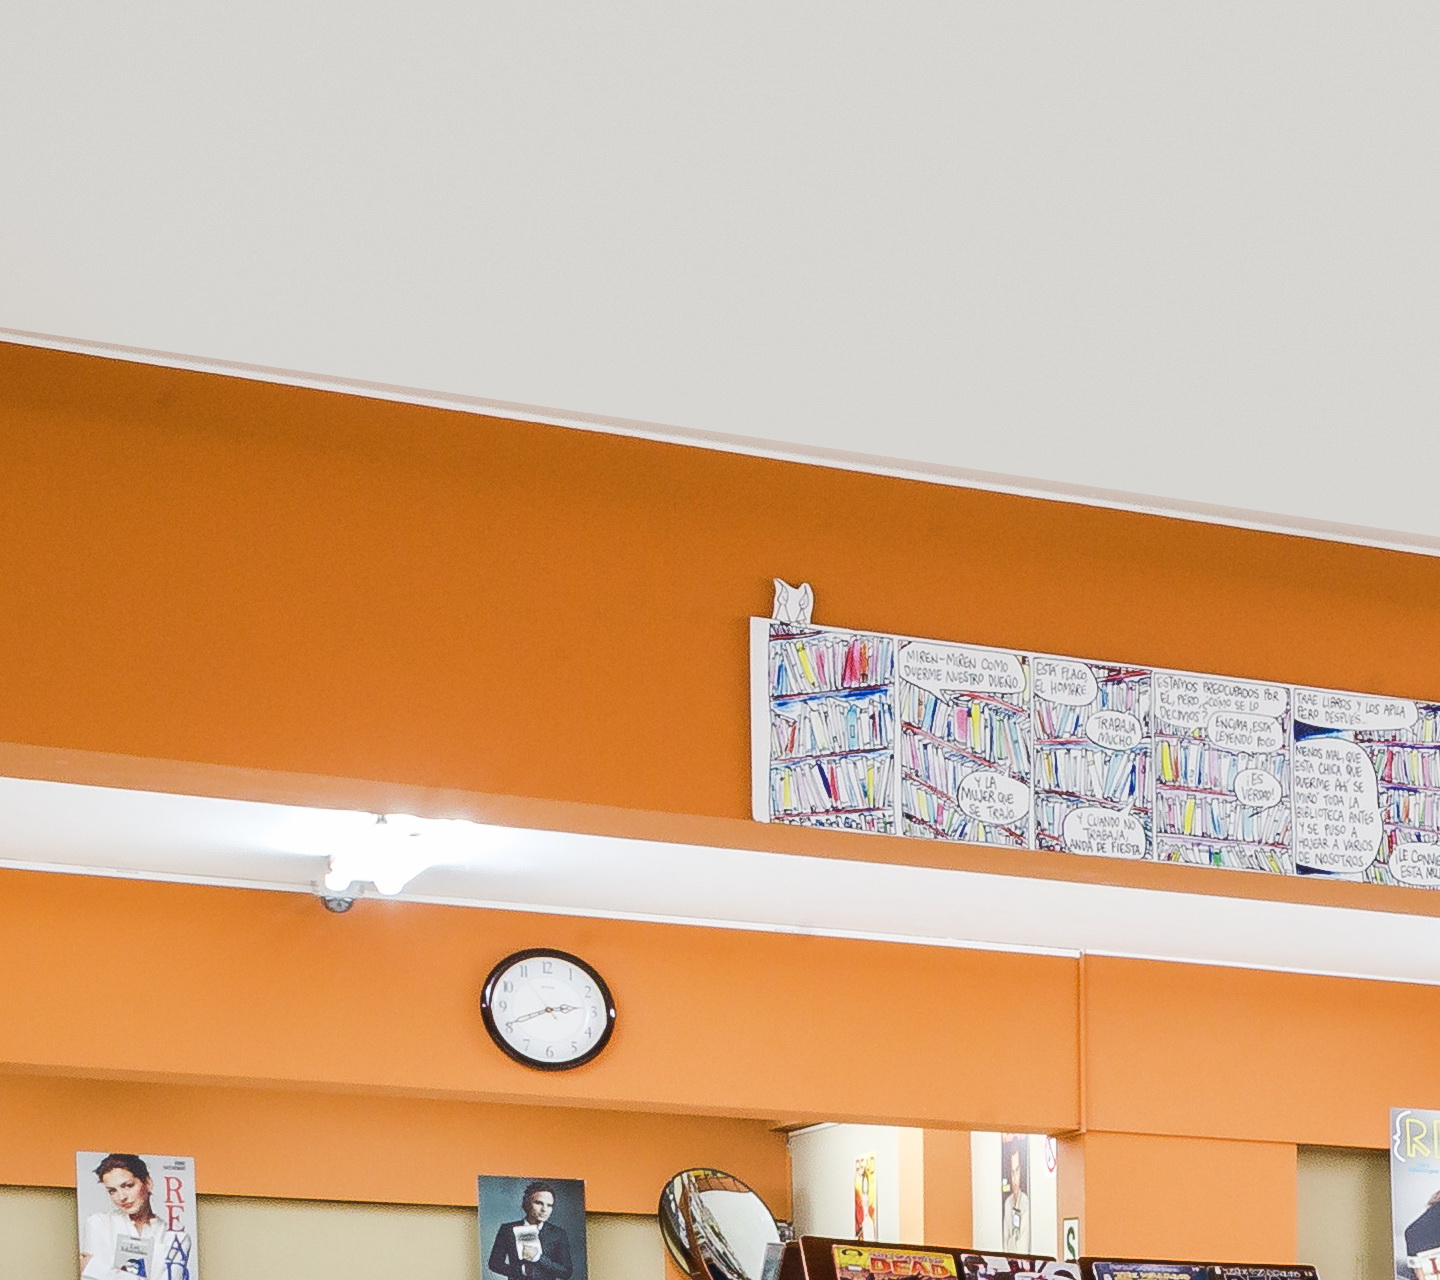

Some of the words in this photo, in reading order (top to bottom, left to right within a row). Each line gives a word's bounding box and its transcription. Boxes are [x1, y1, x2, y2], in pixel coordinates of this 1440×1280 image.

[904, 665, 942, 681] DUERME
[946, 671, 984, 686] NUESTRO
[1034, 680, 1045, 693] EL
[1050, 682, 1087, 696] HOMBRE
[1157, 676, 1198, 693] ESTAMOS
[1203, 682, 1259, 699] PREOCUPADOS
[1264, 689, 1280, 701] POR
[1177, 694, 1199, 708] PERO
[1235, 700, 1245, 711] SE
[1249, 701, 1259, 711] LO
[1297, 693, 1319, 706] TRAE
[1322, 697, 1352, 710] LIBROS
[1356, 702, 1361, 712] Y
[1365, 703, 1380, 715] LOS
[1384, 704, 1406, 719] APILA
[1298, 705, 1319, 721] PERO
[1095, 717, 1136, 735] TRABAJA
[1215, 730, 1253, 745] LEYENDO
[1257, 737, 1276, 747] POCO
[1295, 746, 1323, 760] MENOS
[1345, 751, 1362, 763] QUE
[1295, 760, 1314, 773] ESTA
[1318, 763, 1343, 776] CHICA
[1345, 764, 1363, 777] QUE
[974, 776, 981, 787] Y
[986, 776, 997, 790] LA
[1295, 776, 1330, 792] DUERME
[1353, 781, 1364, 793] SE
[960, 787, 996, 803] MUJER
[997, 792, 1014, 805] QUE
[1323, 794, 1344, 807] TODA
[1349, 796, 1360, 810] LA
[969, 804, 981, 817] SE
[1295, 806, 1344, 823] BIBLIOTECA
[1348, 810, 1374, 825] ANTES
[1077, 812, 1083, 824] Y
[1087, 814, 1120, 828] CUANDO
[1124, 819, 1136, 831] NO
[1299, 822, 1305, 833] Y
[1307, 823, 1320, 836] SE
[1324, 824, 1347, 836] PUSO
[1351, 827, 1358, 838] A
[1070, 839, 1093, 852] ANDA
[1097, 843, 1107, 853] DE
[1332, 839, 1340, 850] A
[1343, 840, 1374, 852] VARIOS
[1299, 851, 1310, 864] DE
[1400, 865, 1423, 879] ESTA
[520, 965, 528, 978] 11
[542, 961, 553, 974] 12
[569, 967, 573, 981] 1
[503, 981, 514, 993] 10
[584, 985, 592, 998] 2
[499, 1000, 507, 1012] 9
[591, 1006, 598, 1018] 3
[584, 1027, 592, 1038] 4
[522, 1039, 530, 1052] 7
[546, 1045, 554, 1058] 6
[571, 1041, 578, 1053] 5
[869, 1257, 952, 1279] DEAD
